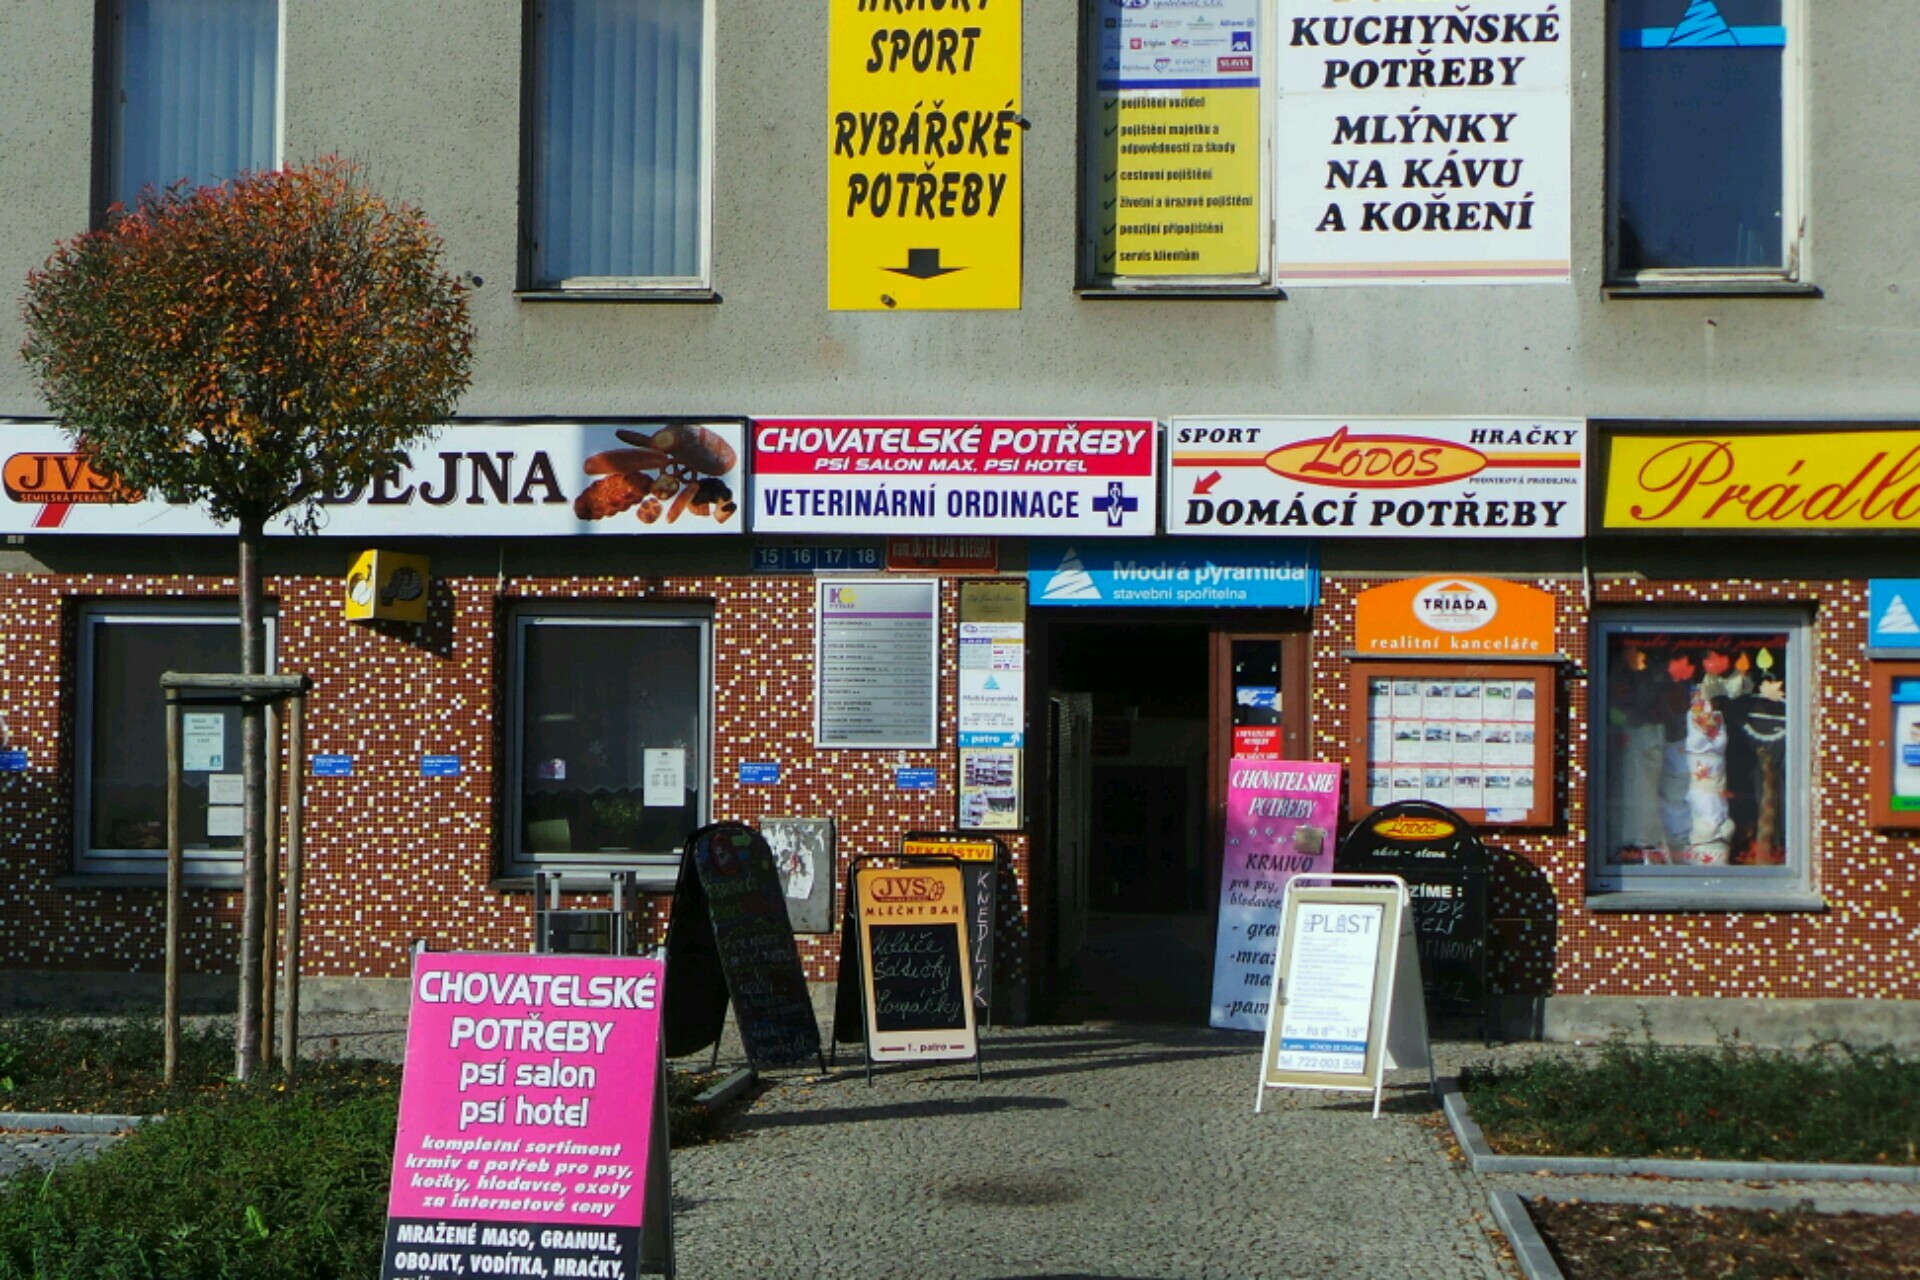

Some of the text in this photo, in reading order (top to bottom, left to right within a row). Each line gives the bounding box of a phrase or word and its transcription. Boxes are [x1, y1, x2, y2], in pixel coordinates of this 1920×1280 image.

[1289, 5, 1560, 46] KUCHYŇSKÉ
[866, 27, 982, 75] SPORT
[1321, 48, 1526, 88] POTŘEBY
[834, 100, 1015, 158] RYBÁŘSKÉ
[1121, 124, 1219, 136] pojištění majetku a
[1331, 105, 1518, 145] MLÝNKY
[1192, 144, 1204, 153] za
[1206, 142, 1235, 154] škody
[1120, 170, 1212, 182] cestovní pojištění
[1325, 149, 1524, 189] NA KÁVU
[847, 161, 1007, 219] POTŘEBY
[1120, 196, 1154, 208] životní
[1155, 198, 1162, 207] a
[1206, 195, 1253, 208] pojištění
[1315, 191, 1535, 231] A KOŘENÍ
[1120, 221, 1224, 235] penzijní připojištění
[1120, 249, 1200, 261] servis klientům
[756, 423, 1147, 456] CHOVATELSKÉ POTŘEBY
[1177, 428, 1261, 444] SPORT
[1469, 425, 1580, 445] HRAČKY
[19, 456, 113, 490] JVS
[814, 457, 1087, 473] PSÍ SALON MAX. PSÍ HOTEL
[1469, 475, 1524, 485] PODNIKOVÁ
[764, 483, 1079, 518] VETERINÁRNÍ ORDINACE
[1185, 492, 1568, 528] DOMÁCÍ POTŘEBY
[760, 549, 779, 564] 15
[792, 549, 811, 564] 16
[825, 549, 843, 564] 17
[857, 549, 876, 564] 18
[1113, 560, 1305, 585] Modrá pyramida
[1113, 587, 1247, 603] stavební spořitelna
[1424, 598, 1488, 610] TRIADA
[1371, 635, 1539, 650] realitní kanceláře
[960, 734, 1000, 746] 1. patro
[1246, 853, 1313, 873] KRMIVO
[880, 878, 927, 896] JVS
[865, 905, 959, 916] MLÉČNÝ BAR
[419, 970, 658, 1010] CHOVATELSKÉ
[449, 1011, 615, 1054] POTŘEBY
[908, 1043, 947, 1052] 1. patro
[1297, 1056, 1318, 1067] 722
[1319, 1057, 1340, 1069] 003
[458, 1058, 597, 1092] psí salon
[458, 1096, 590, 1131] psí hotel
[422, 1135, 622, 1157] kompletní sortiment
[404, 1153, 635, 1179] krmiv a potřeb pro psy,
[410, 1172, 632, 1199] kočky, hlodavce, exoty
[422, 1193, 616, 1218] za internetové ceny
[397, 1222, 623, 1254] MRAŽENÉ MASO, GRANULE,
[394, 1252, 626, 1280] OBOJKY, VODÍTKA, HRAČKY,
